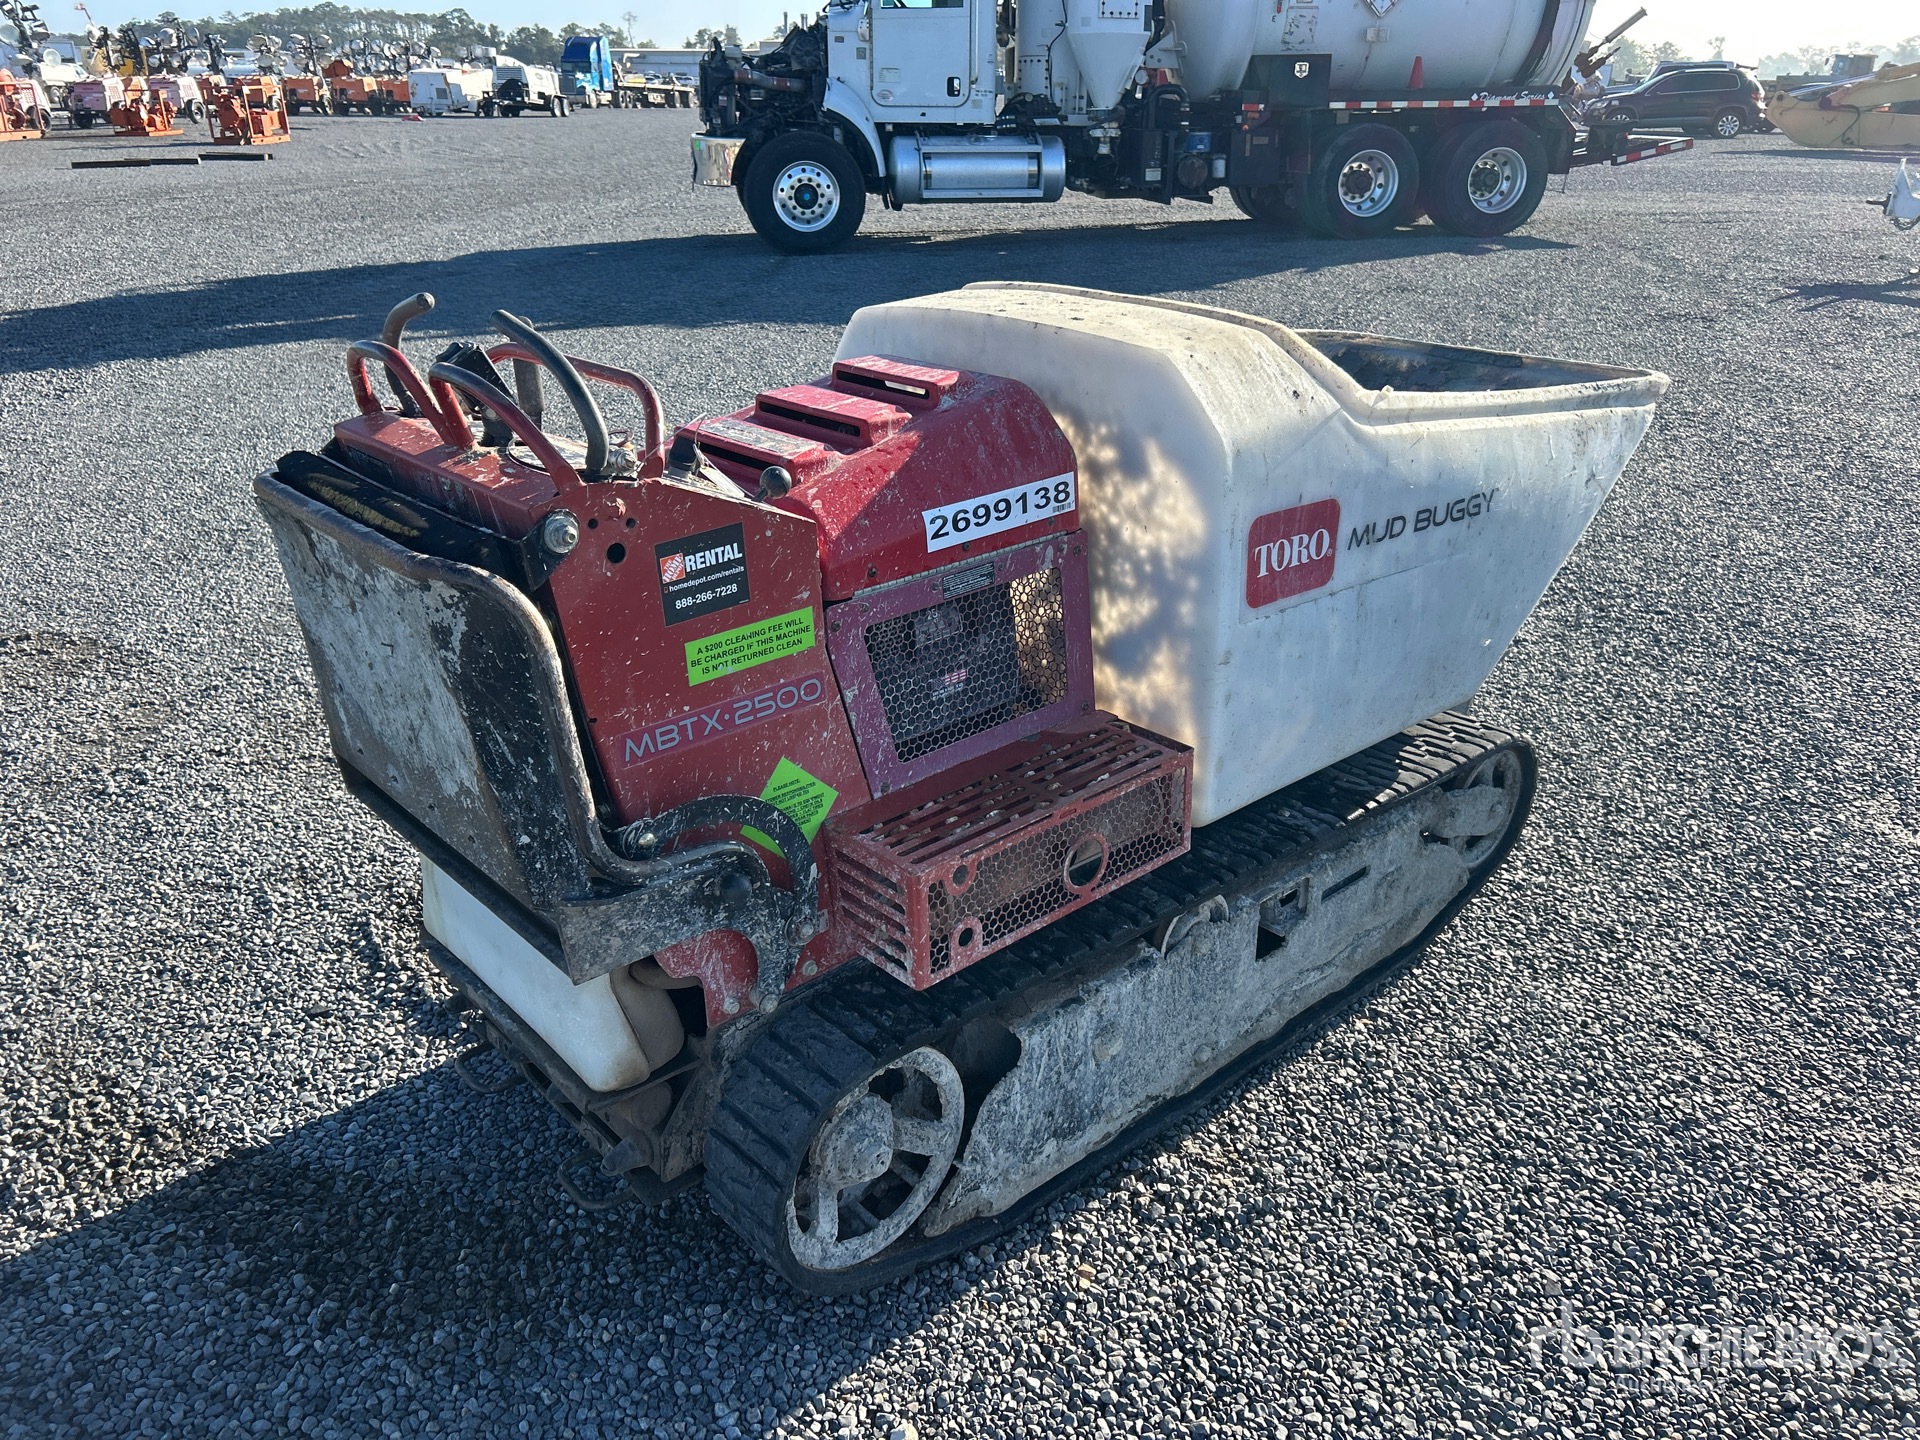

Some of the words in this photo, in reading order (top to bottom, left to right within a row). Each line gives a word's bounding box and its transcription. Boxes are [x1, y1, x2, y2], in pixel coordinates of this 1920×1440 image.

[1479, 91, 1519, 101] Diamond
[1520, 90, 1545, 100] Series
[929, 481, 1071, 541] 2699138
[1347, 515, 1406, 551] MUD
[1412, 490, 1496, 533] BUGGY
[684, 542, 743, 573] RENTAL
[1253, 528, 1332, 578] TORO
[668, 565, 745, 593] homedepot.com/rentals
[675, 583, 738, 610] 888-266-7228
[691, 657, 702, 668] BE
[704, 645, 745, 664] CHARGED
[747, 642, 754, 650] IF
[756, 636, 774, 648] THIS
[775, 625, 811, 641] MACHINE
[696, 647, 703, 655] A
[704, 642, 723, 653] $200
[725, 628, 766, 647] CLEANING
[768, 623, 783, 634] FEE
[784, 617, 804, 629] WILL
[702, 666, 710, 675] IS
[712, 660, 729, 672] NOT
[731, 646, 775, 666] RETURNED
[776, 637, 803, 651] CLEAN
